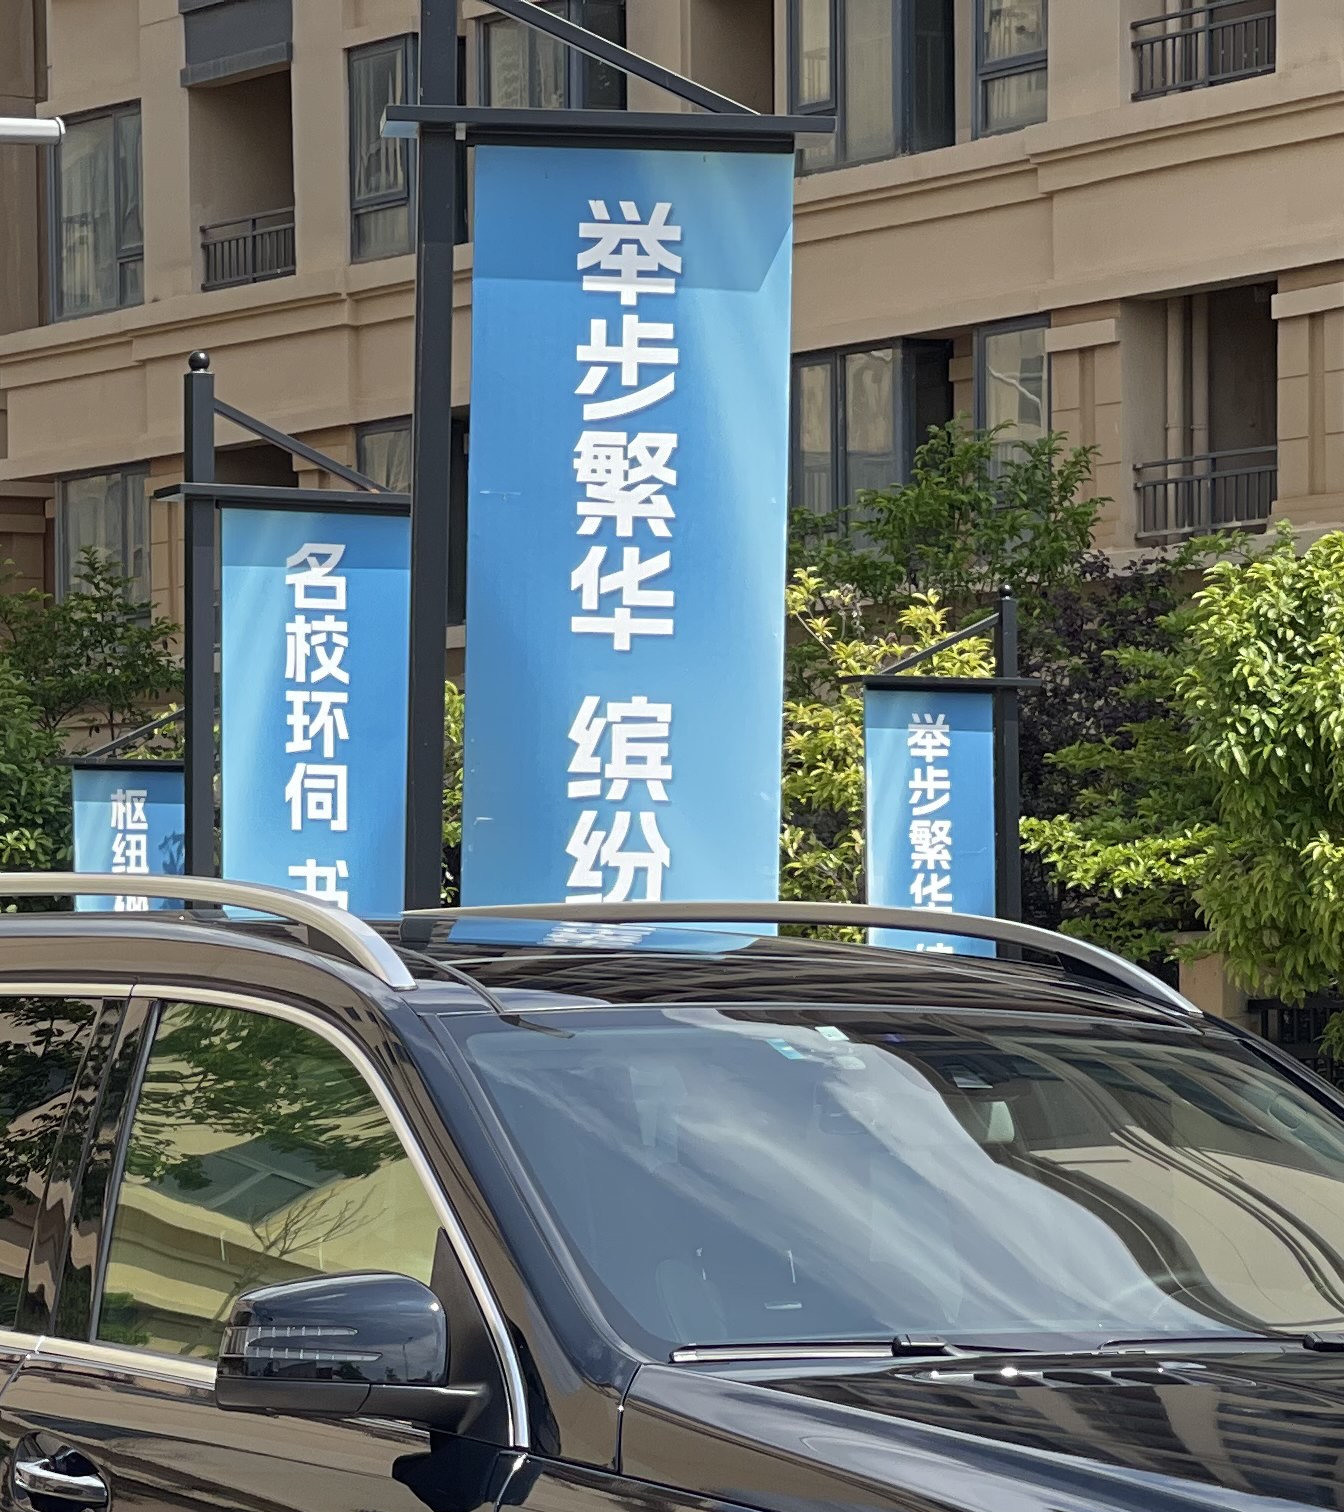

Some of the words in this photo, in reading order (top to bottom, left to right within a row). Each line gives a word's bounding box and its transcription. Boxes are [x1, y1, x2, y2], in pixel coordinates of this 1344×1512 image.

[570, 199, 682, 652] 举步繁华
[284, 542, 350, 832] 名校环伺
[565, 694, 673, 903] 缤纷
